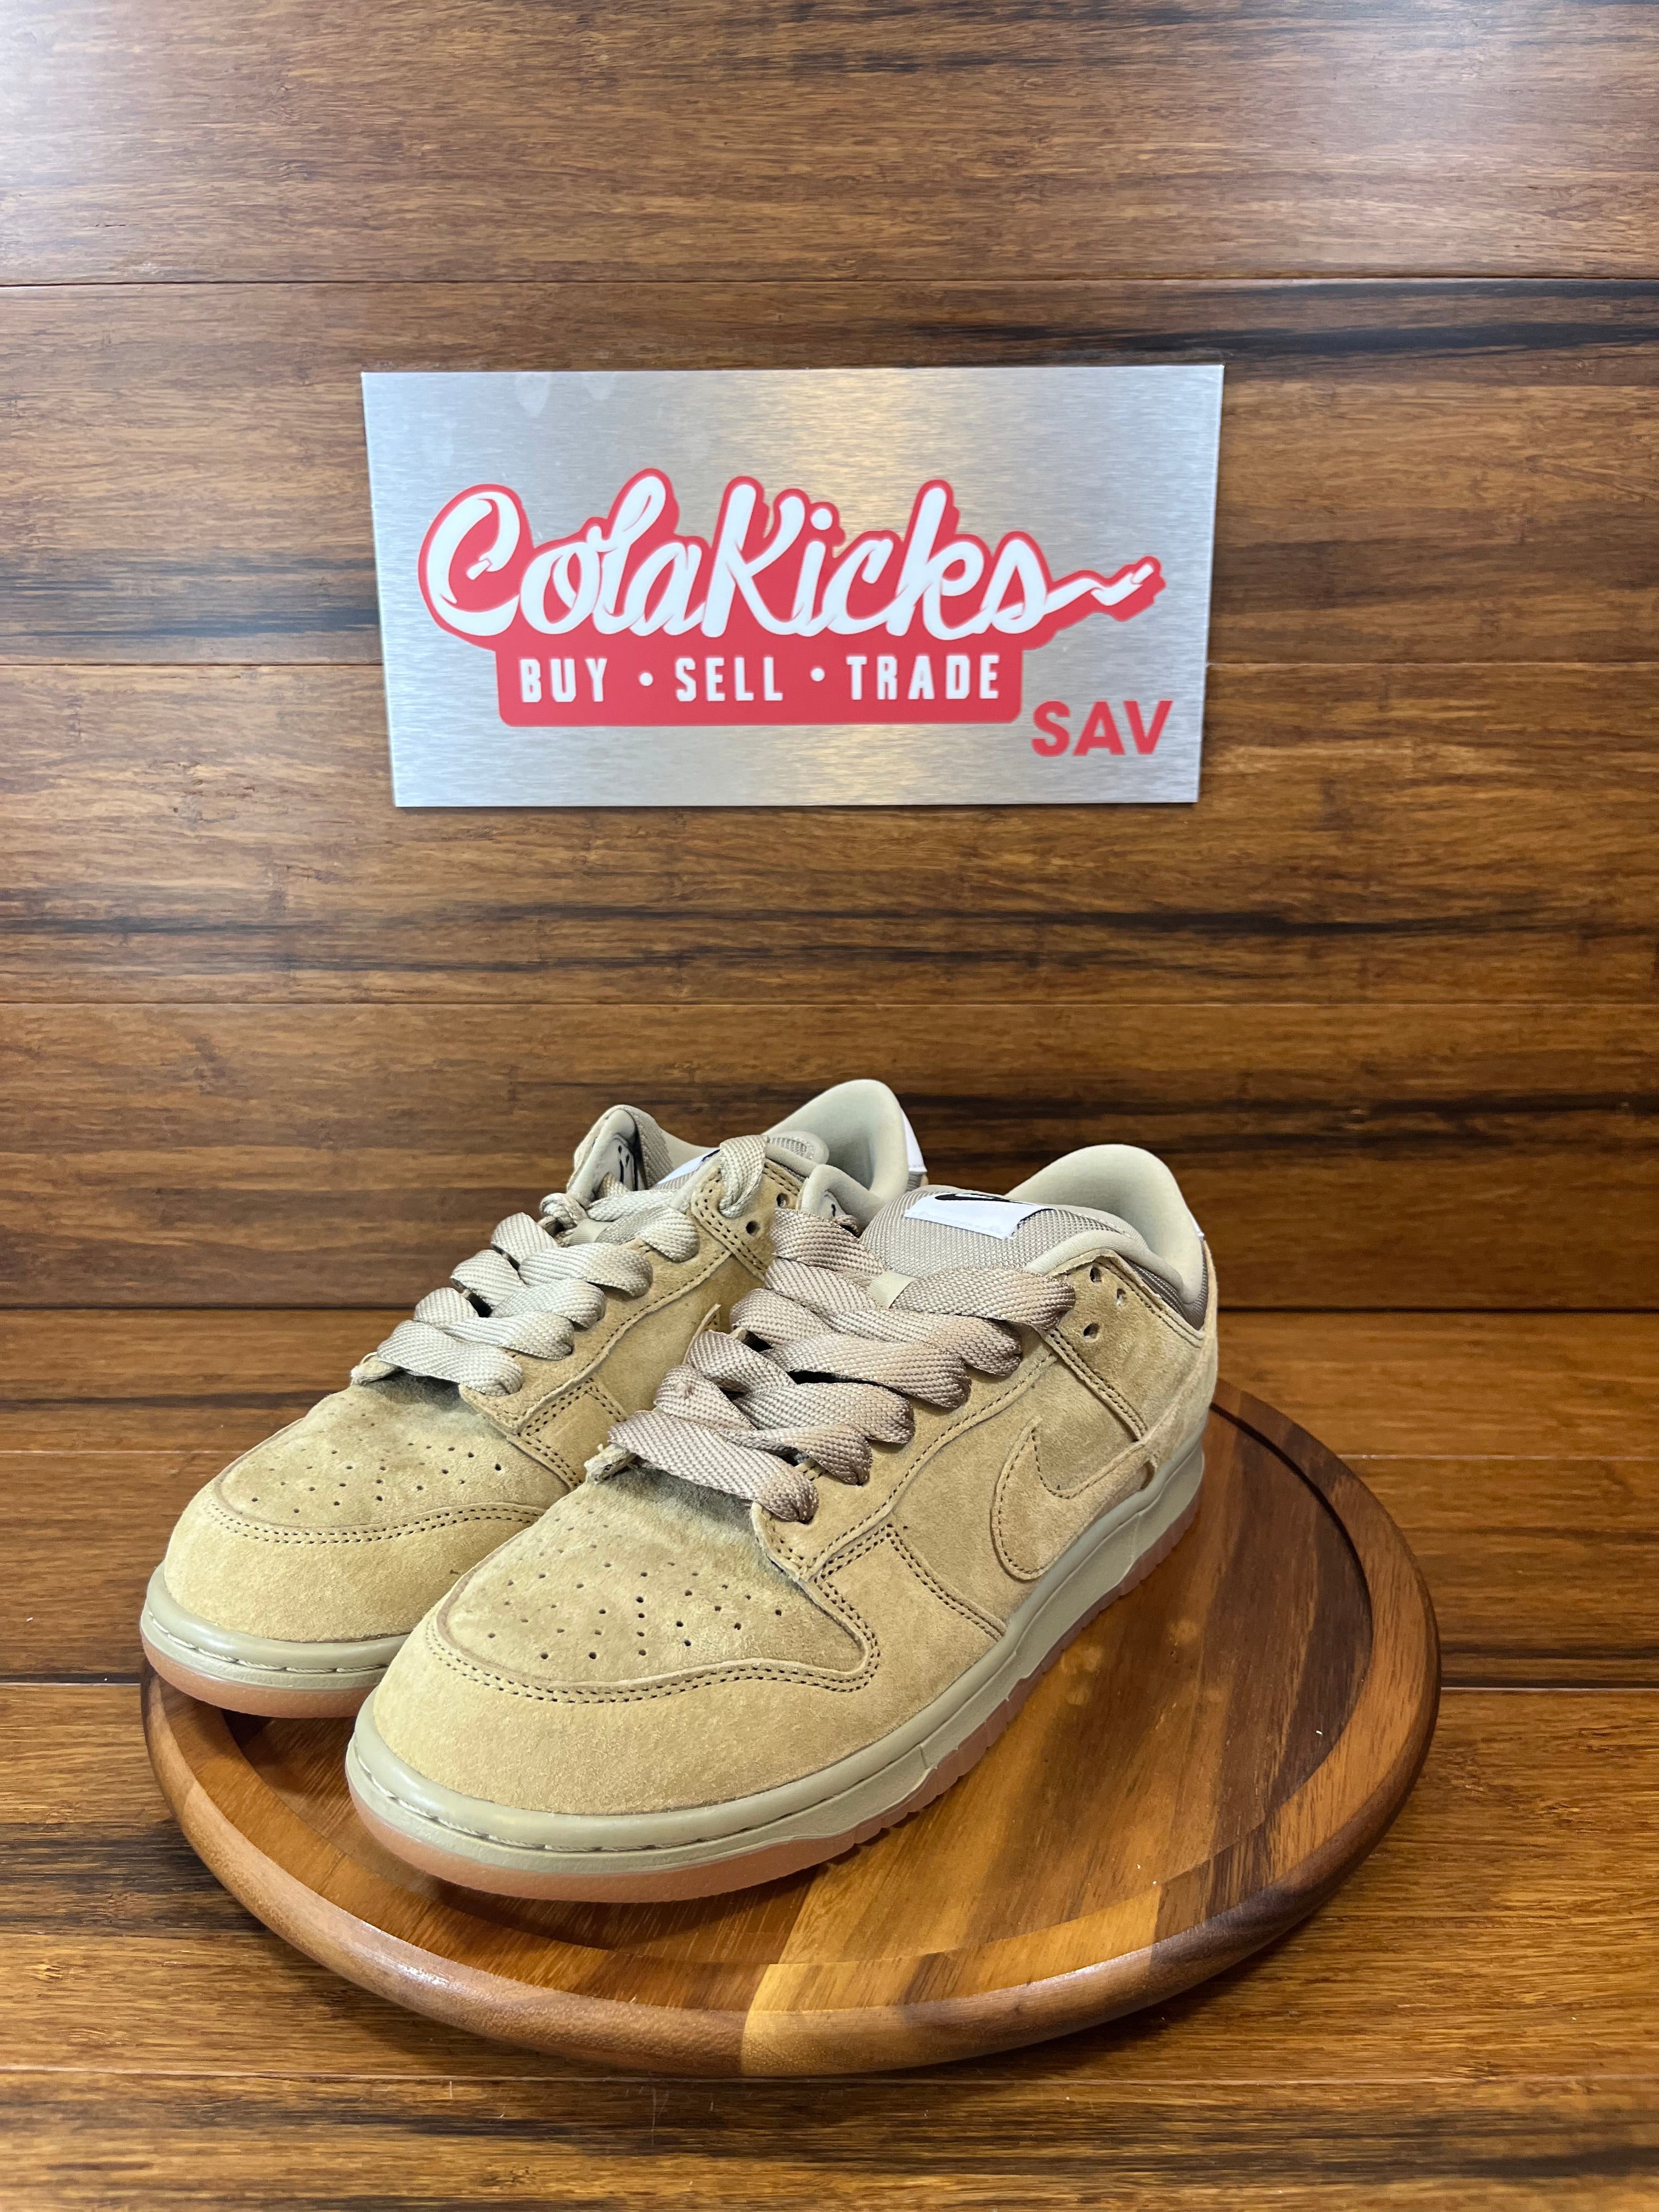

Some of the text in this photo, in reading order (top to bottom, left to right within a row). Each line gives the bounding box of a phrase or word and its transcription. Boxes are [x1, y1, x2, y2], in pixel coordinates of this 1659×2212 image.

[429, 473, 1155, 640] ColaKicks
[520, 654, 998, 703] BUY SELL TRADE
[1030, 699, 1173, 757] SAV
